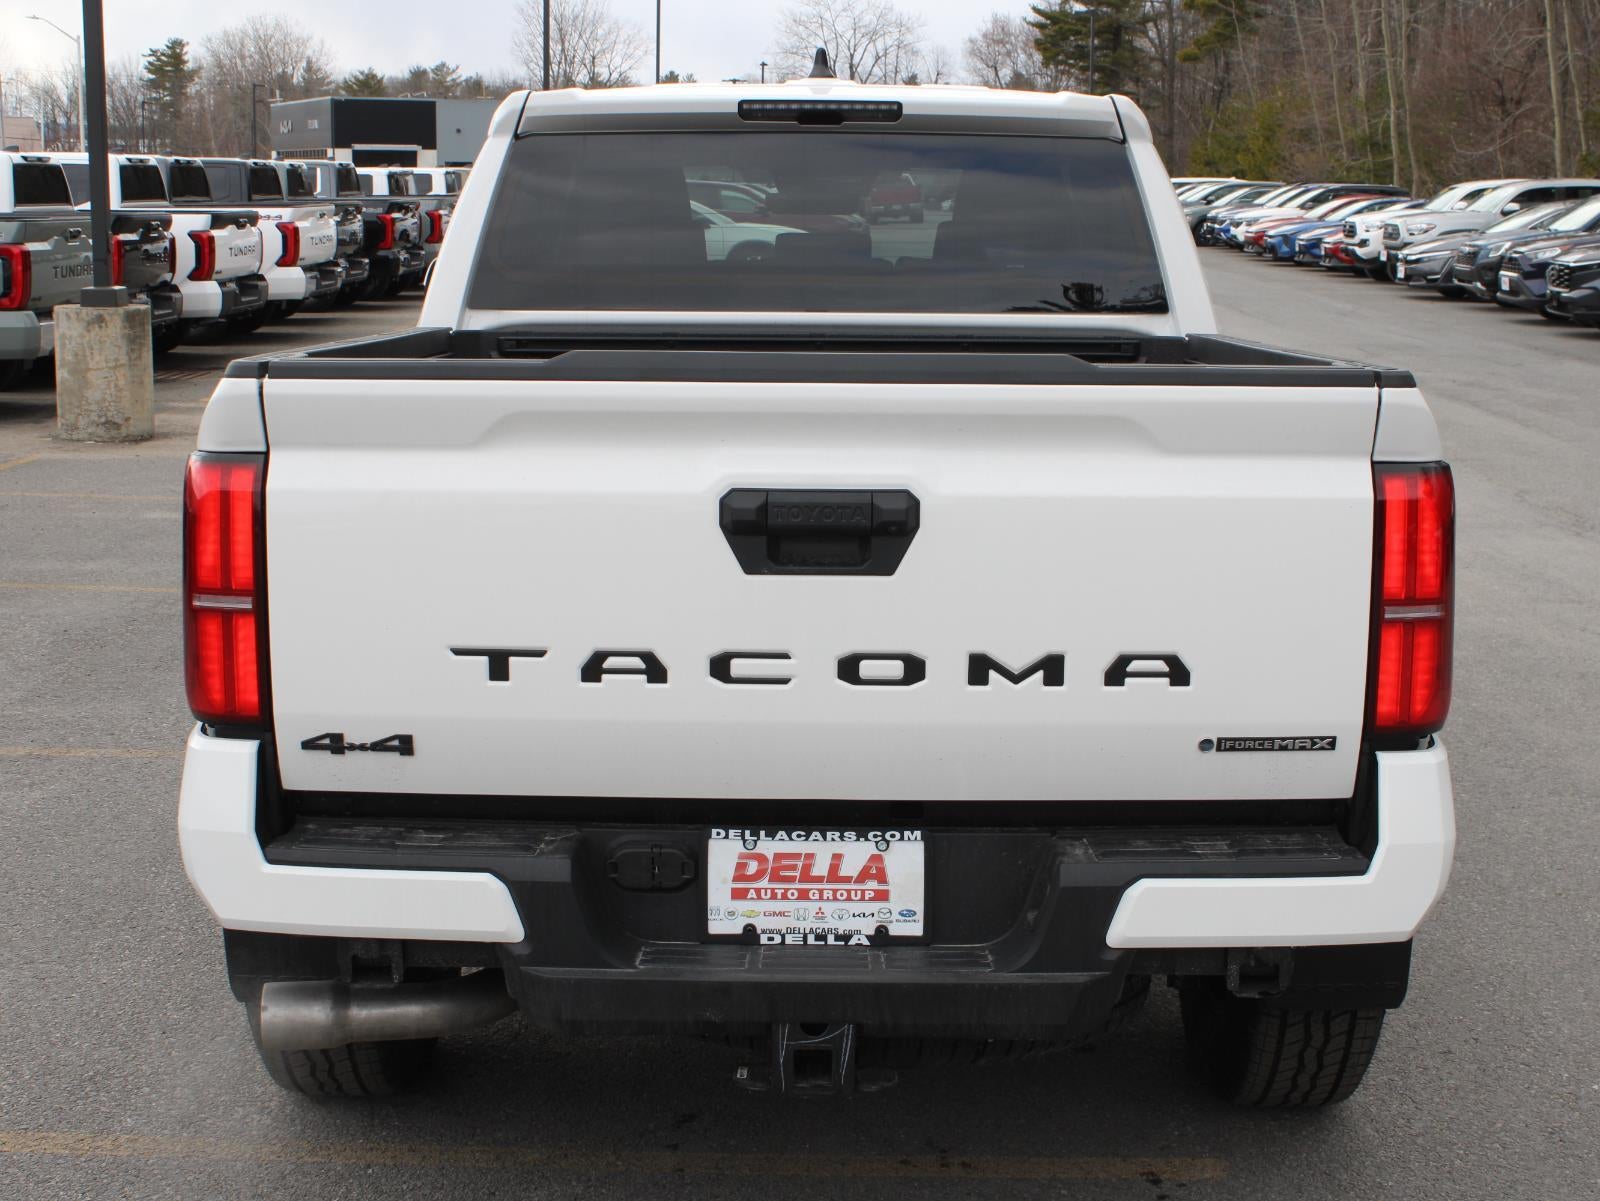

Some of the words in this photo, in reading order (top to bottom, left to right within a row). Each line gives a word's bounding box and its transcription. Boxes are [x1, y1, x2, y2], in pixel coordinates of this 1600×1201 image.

[228, 244, 256, 257] TUNDRA
[773, 504, 867, 523] TOYOTA
[449, 647, 1191, 688] TACOMA
[711, 828, 922, 842] DELLACARS.COM
[731, 851, 889, 886] DELLA
[746, 888, 798, 900] AUTO
[808, 889, 875, 901] GROUP
[763, 910, 792, 918] GMC
[760, 926, 862, 935] www.DELLACARS.com
[759, 933, 871, 946] DELLA
